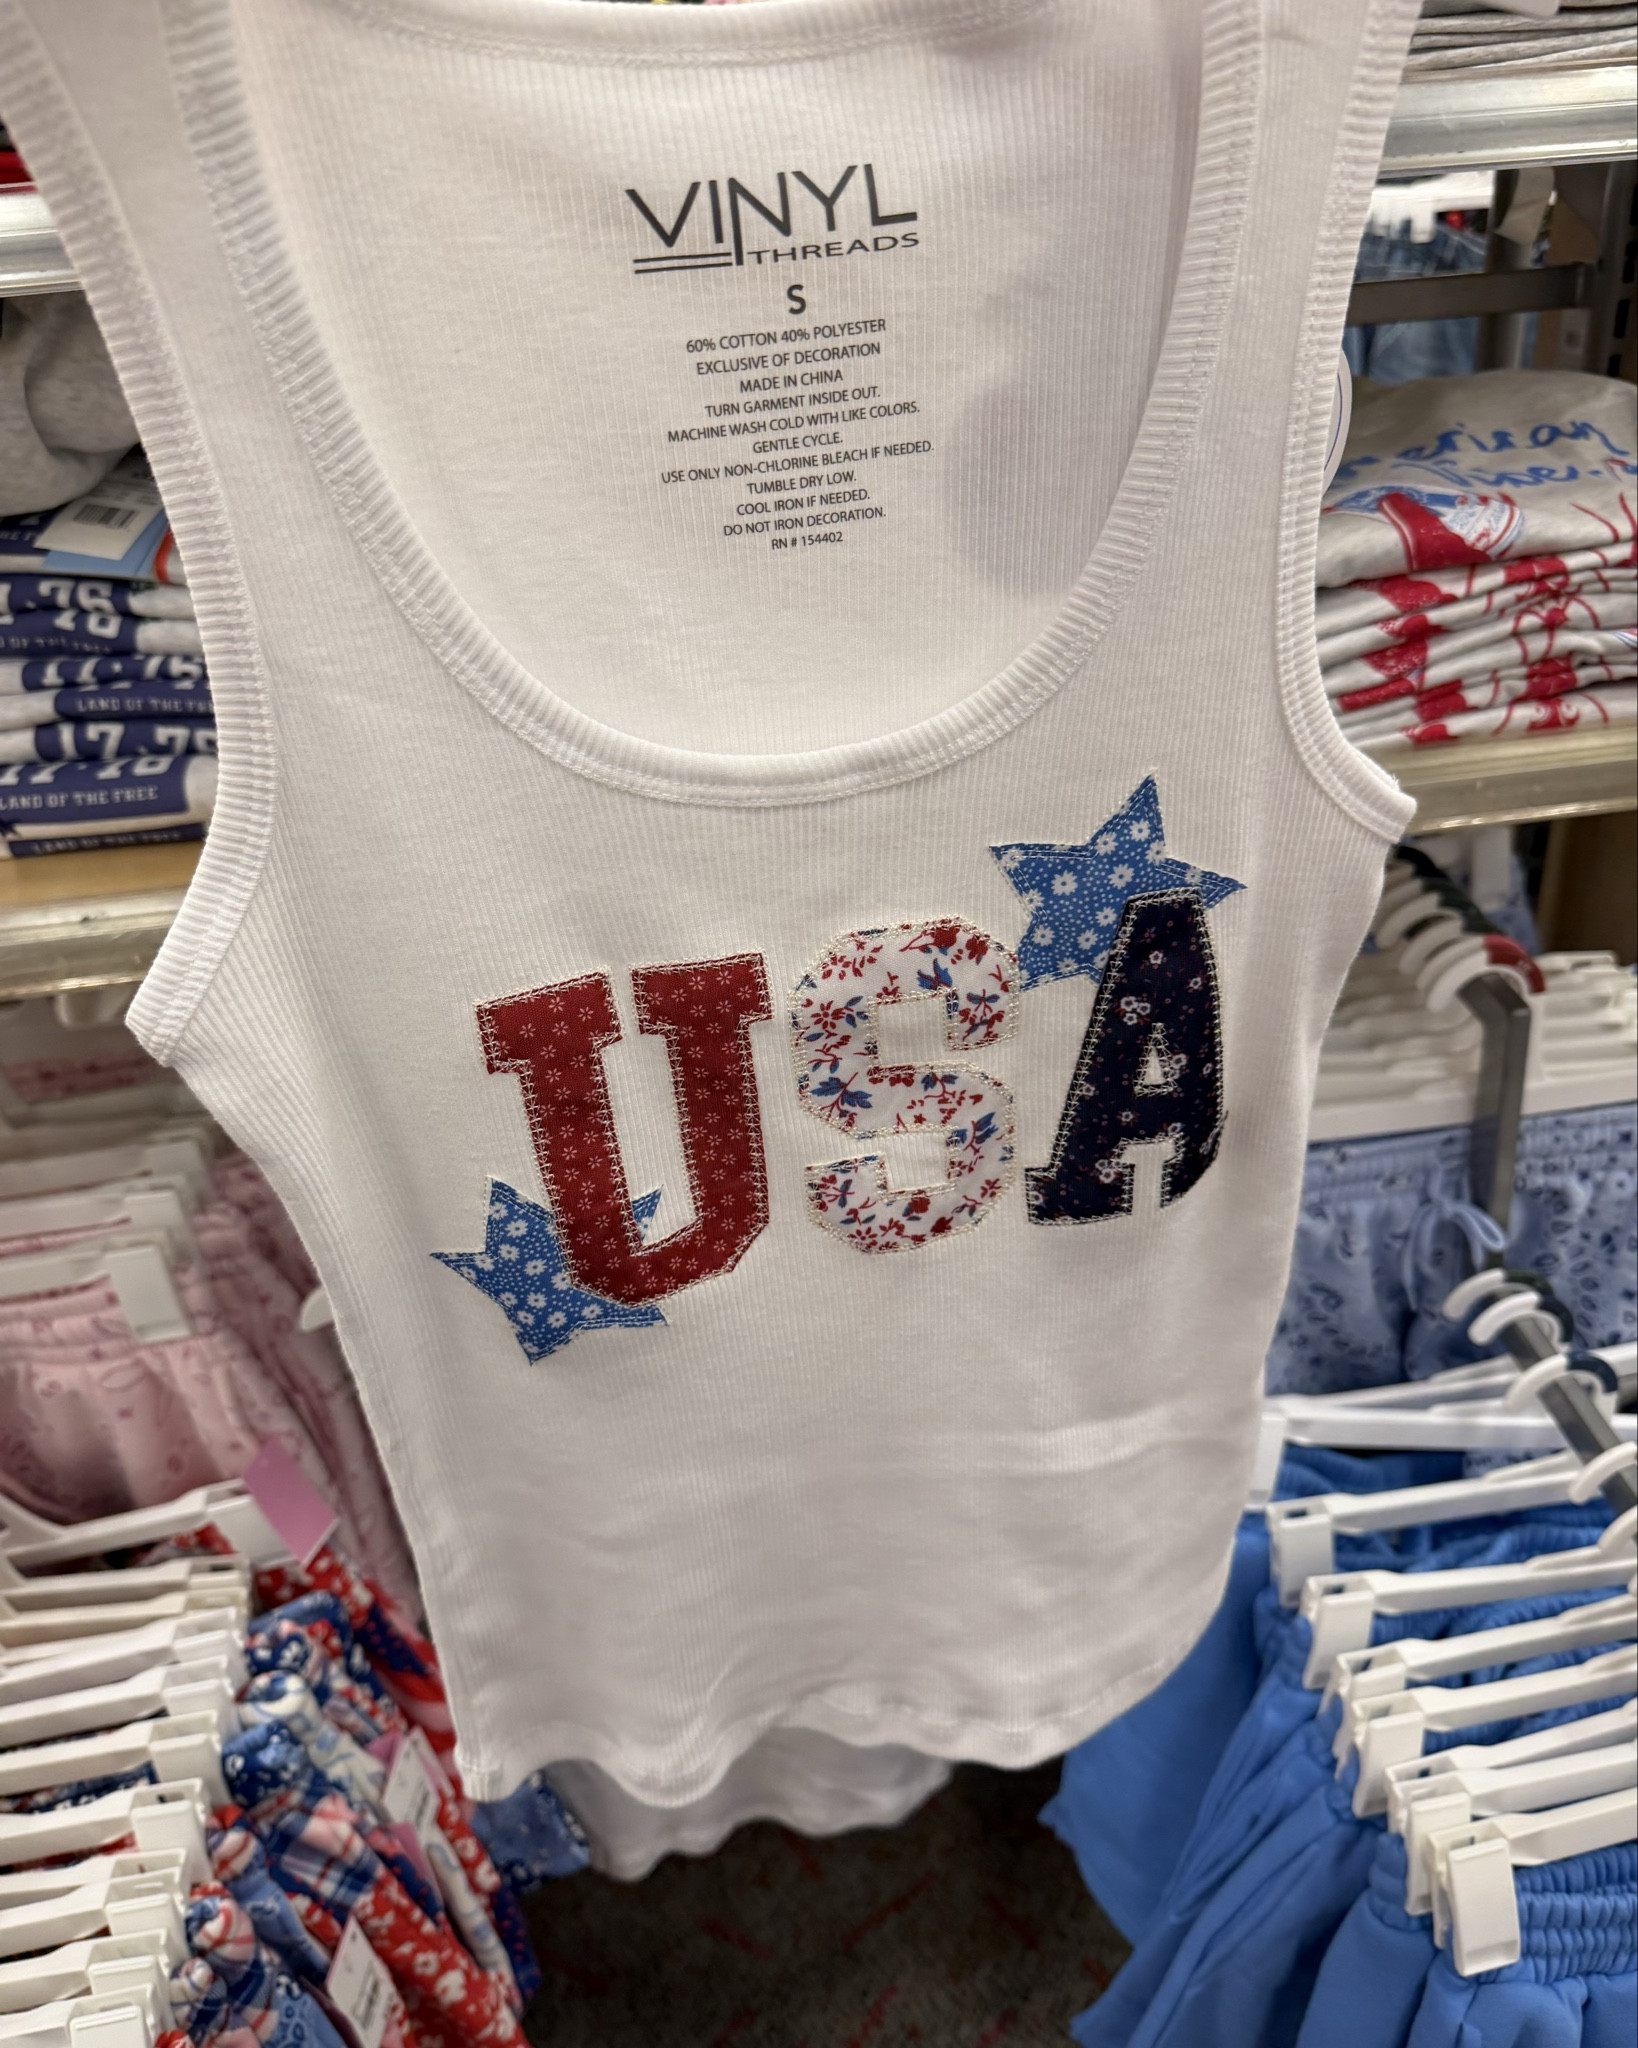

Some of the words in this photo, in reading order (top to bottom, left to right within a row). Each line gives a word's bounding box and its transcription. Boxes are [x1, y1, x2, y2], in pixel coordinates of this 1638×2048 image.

[625, 163, 918, 266] VINYL
[747, 232, 920, 264] THREADS
[787, 284, 807, 314] S
[686, 339, 716, 353] 60%
[719, 332, 777, 350] COTTON
[781, 329, 810, 343] 40%
[813, 319, 886, 340] POLYESTER
[697, 356, 769, 375] EXCLUSIVE
[772, 353, 790, 367] OF
[794, 342, 881, 365] DECORATION
[740, 377, 780, 393] MADE
[784, 376, 797, 388] IN
[800, 369, 843, 386] CHINA
[705, 403, 740, 418] TURN
[743, 395, 806, 414] GARMENT
[809, 390, 849, 406] INSIDE
[852, 386, 881, 401] OUT.
[668, 425, 727, 443] MACHINE
[730, 420, 766, 436] WASH
[769, 416, 804, 432] COLD
[807, 411, 839, 427] WITH
[842, 407, 867, 422] LIKE
[870, 401, 920, 419] COLORS.
[753, 437, 799, 454] GENTLE
[803, 432, 843, 448] CYCLE.
[662, 470, 685, 484] USE
[688, 466, 721, 481] ONLY
[724, 455, 819, 477] NON-CHLORINE
[822, 449, 868, 466] BLEACH
[872, 447, 881, 459] IF
[884, 440, 934, 457] NEEDED.
[747, 479, 797, 495] TUMBLE
[800, 475, 824, 489] DRY
[827, 470, 857, 486] LOW.
[736, 502, 771, 516] COOL
[775, 498, 804, 512] IRON
[807, 496, 817, 508] IF
[820, 488, 870, 506] NEEDED.
[724, 524, 742, 536] DO
[745, 520, 771, 533] NOT
[775, 517, 804, 531] IRON
[807, 506, 886, 528] DECORATION.
[771, 538, 788, 550] RN
[791, 537, 798, 547] #
[801, 531, 843, 546] 154402
[0, 793, 43, 811] LAND
[46, 791, 69, 808] OF
[72, 789, 110, 807] THE
[112, 785, 159, 803] FREE
[473, 886, 1230, 1307] USA
